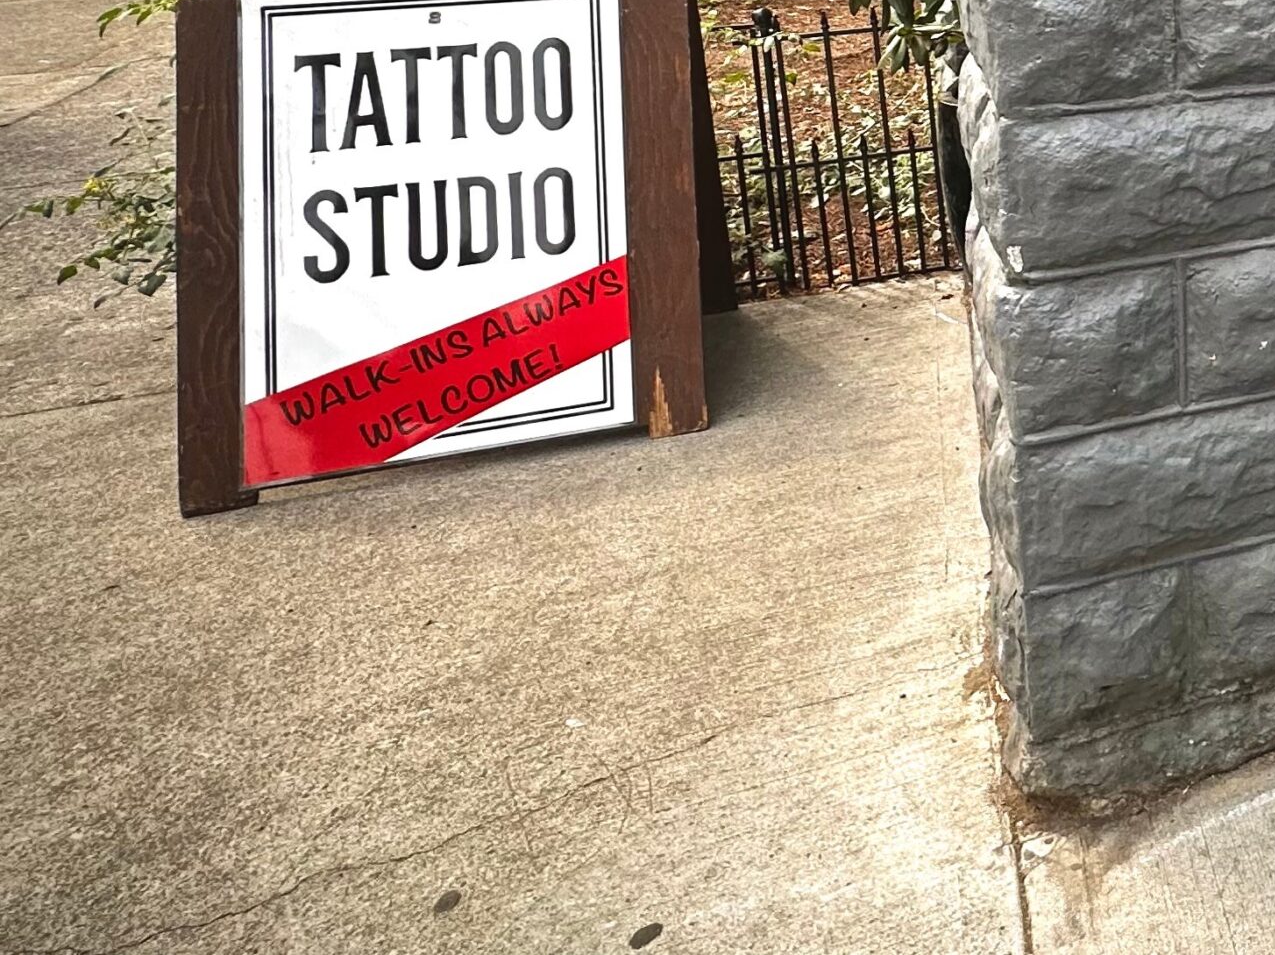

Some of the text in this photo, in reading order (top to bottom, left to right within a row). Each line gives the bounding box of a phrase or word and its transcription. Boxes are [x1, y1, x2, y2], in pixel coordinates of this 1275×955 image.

[294, 37, 573, 153] TATTOO
[303, 167, 576, 284] STUDIO
[279, 267, 625, 427] WALK-INS ALWAYS
[359, 343, 564, 449] WELCOME!
